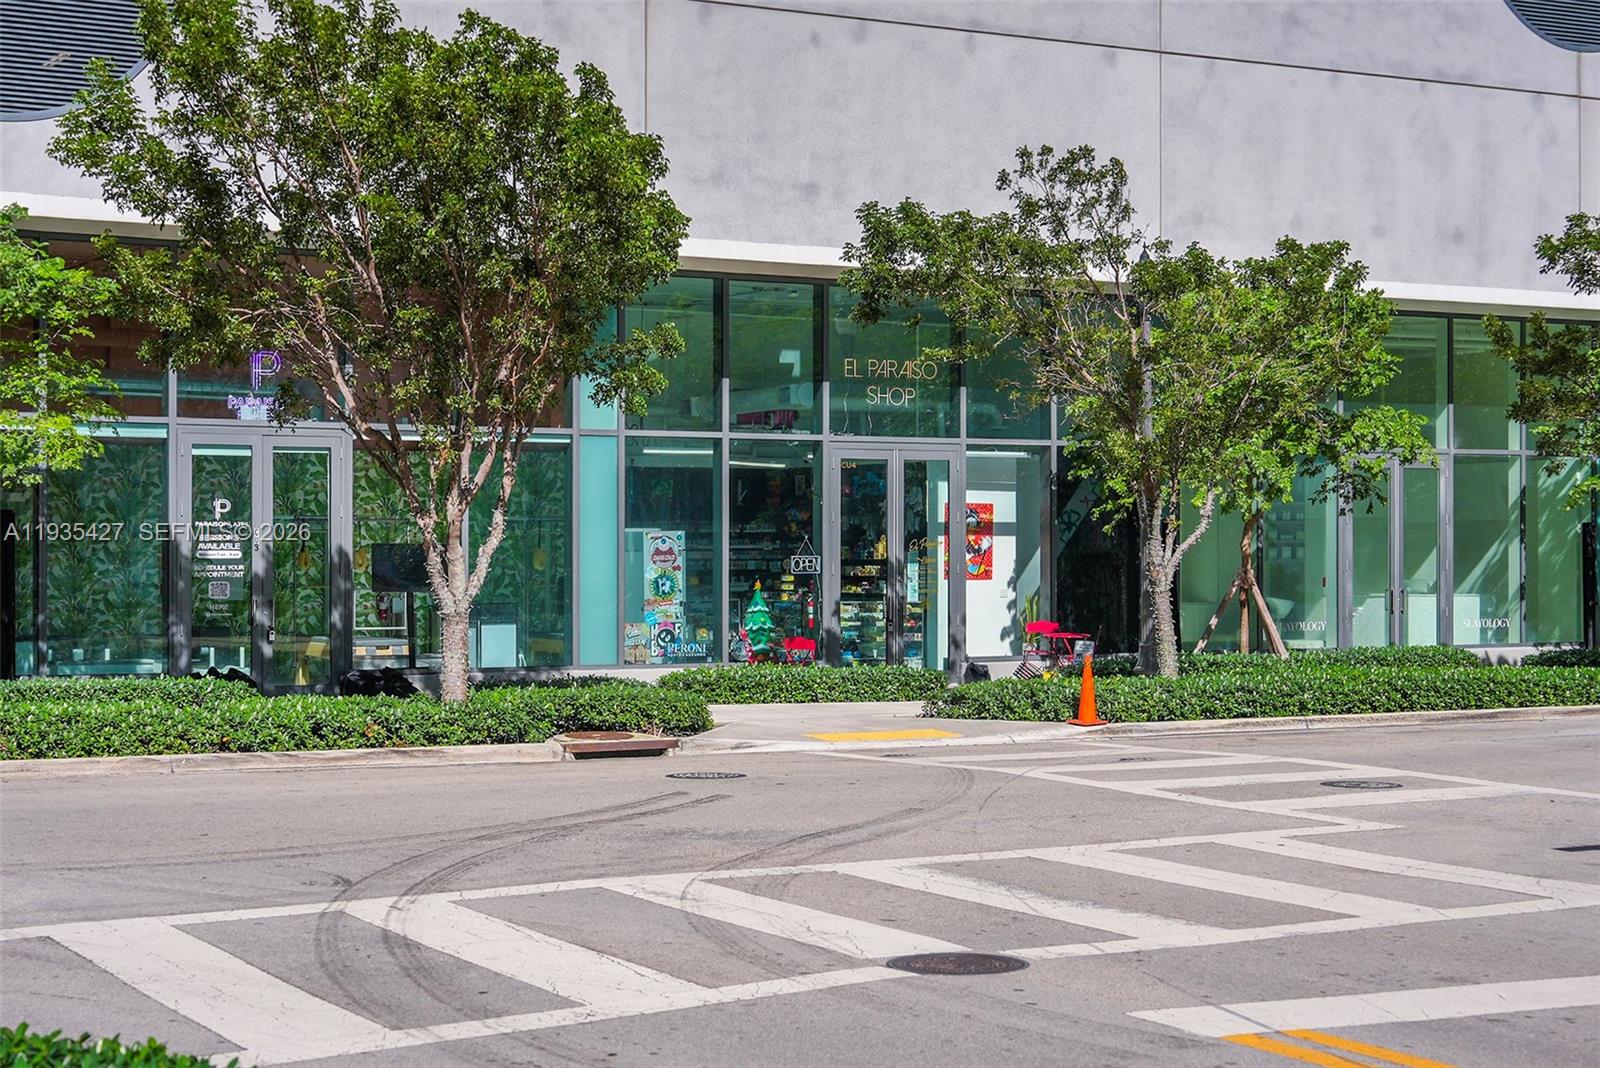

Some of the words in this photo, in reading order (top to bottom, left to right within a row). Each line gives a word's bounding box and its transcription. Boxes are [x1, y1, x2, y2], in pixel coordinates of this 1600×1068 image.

[844, 358, 863, 377] EL
[868, 359, 938, 379] PARAISO
[866, 385, 916, 408] SHOP
[841, 461, 857, 469] CU4
[792, 557, 819, 572] OPEN
[667, 643, 706, 654] PERONI
